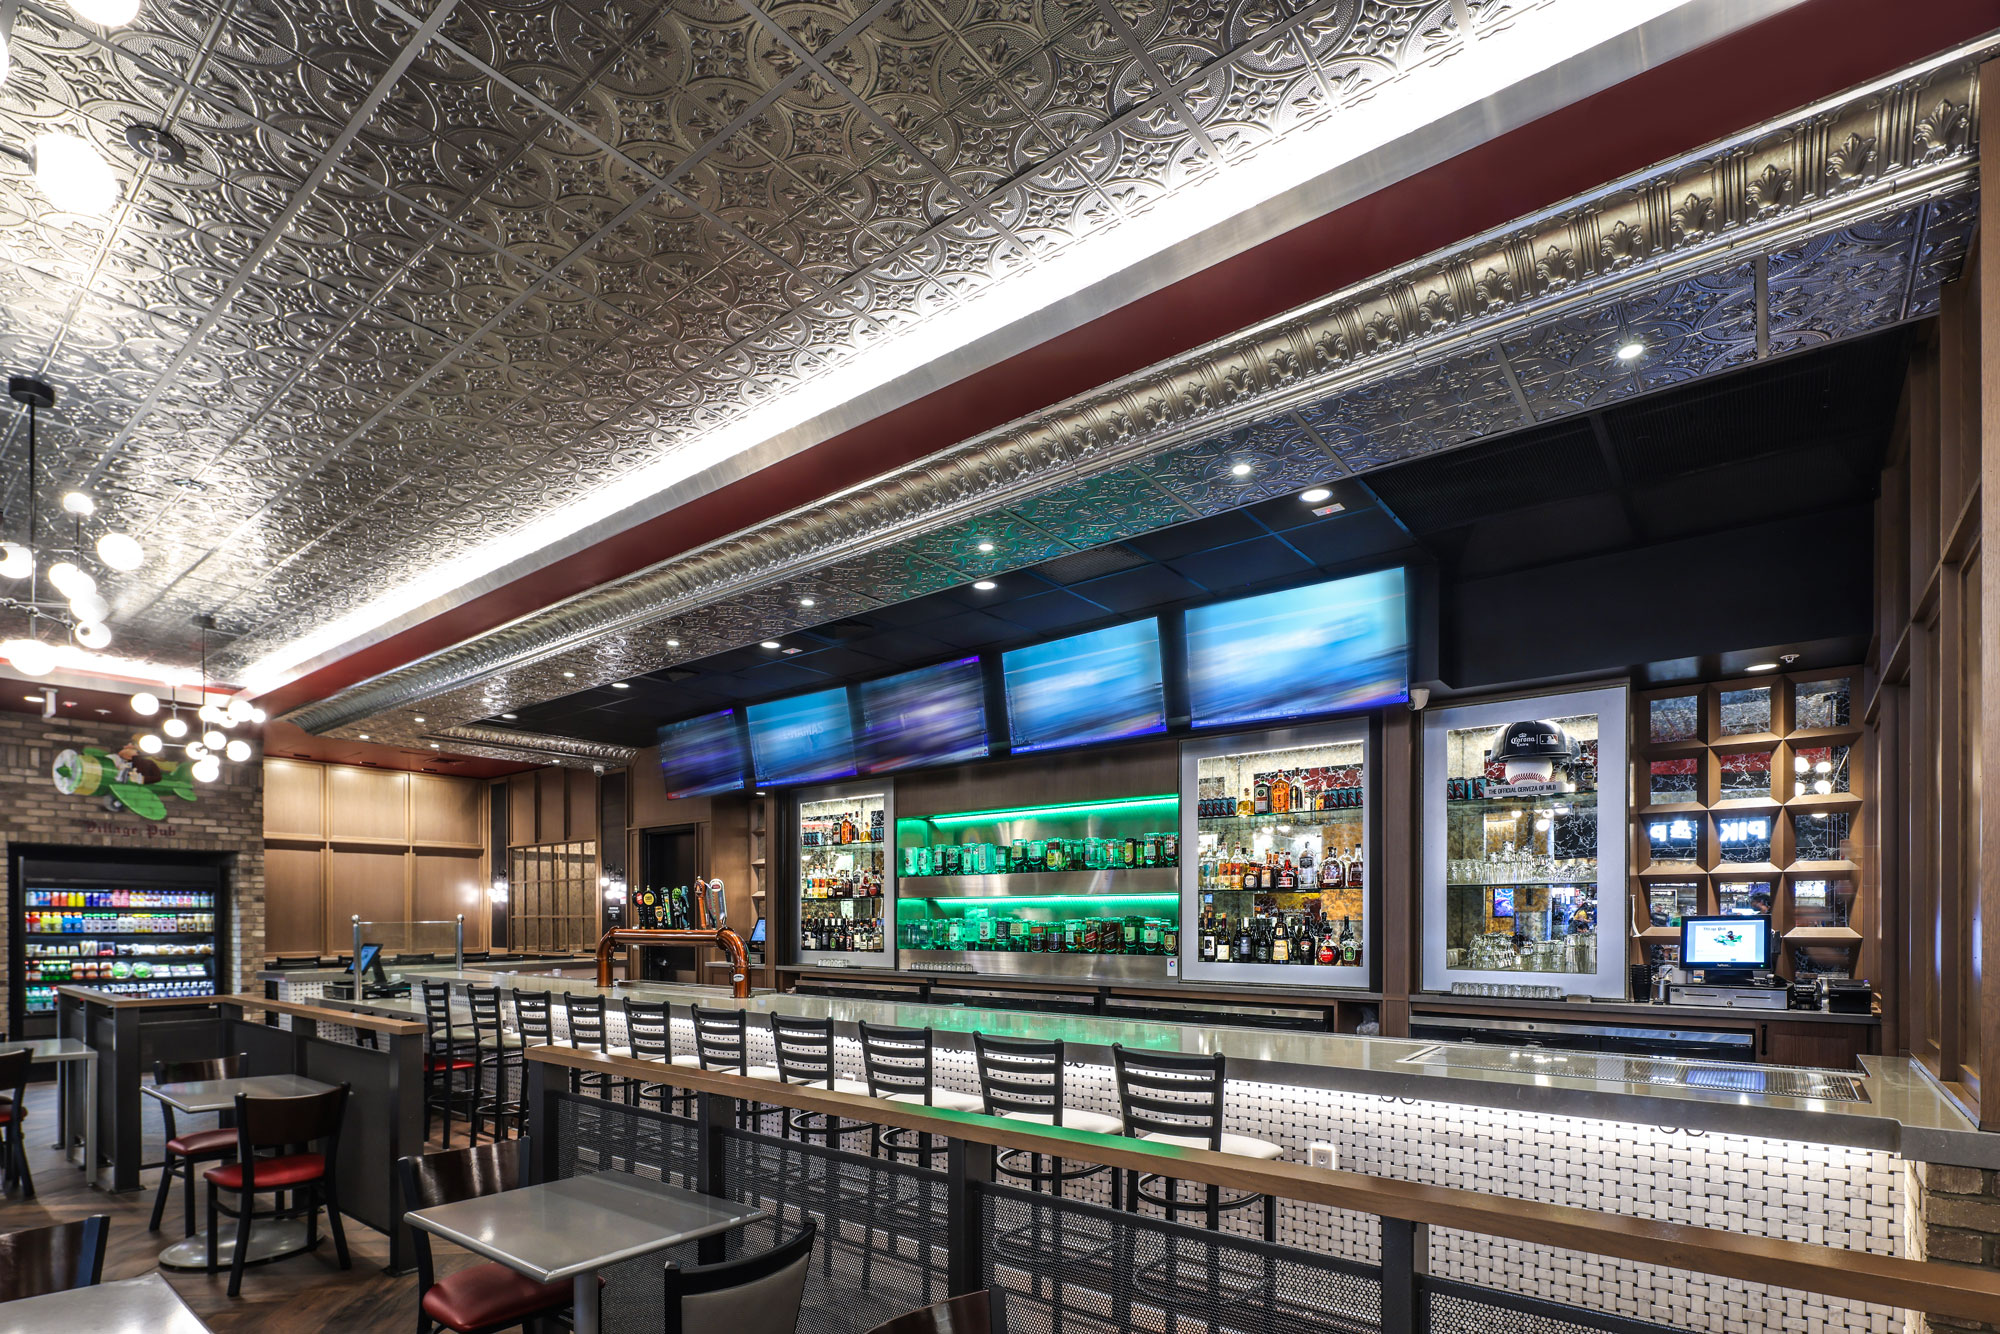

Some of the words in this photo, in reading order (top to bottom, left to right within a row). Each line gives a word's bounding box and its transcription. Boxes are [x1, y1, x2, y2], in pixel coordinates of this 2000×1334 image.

[1511, 736, 1535, 744] Corona
[1498, 787, 1517, 795] OFFICIAL
[84, 820, 138, 837] Village
[146, 824, 177, 839] Pub
